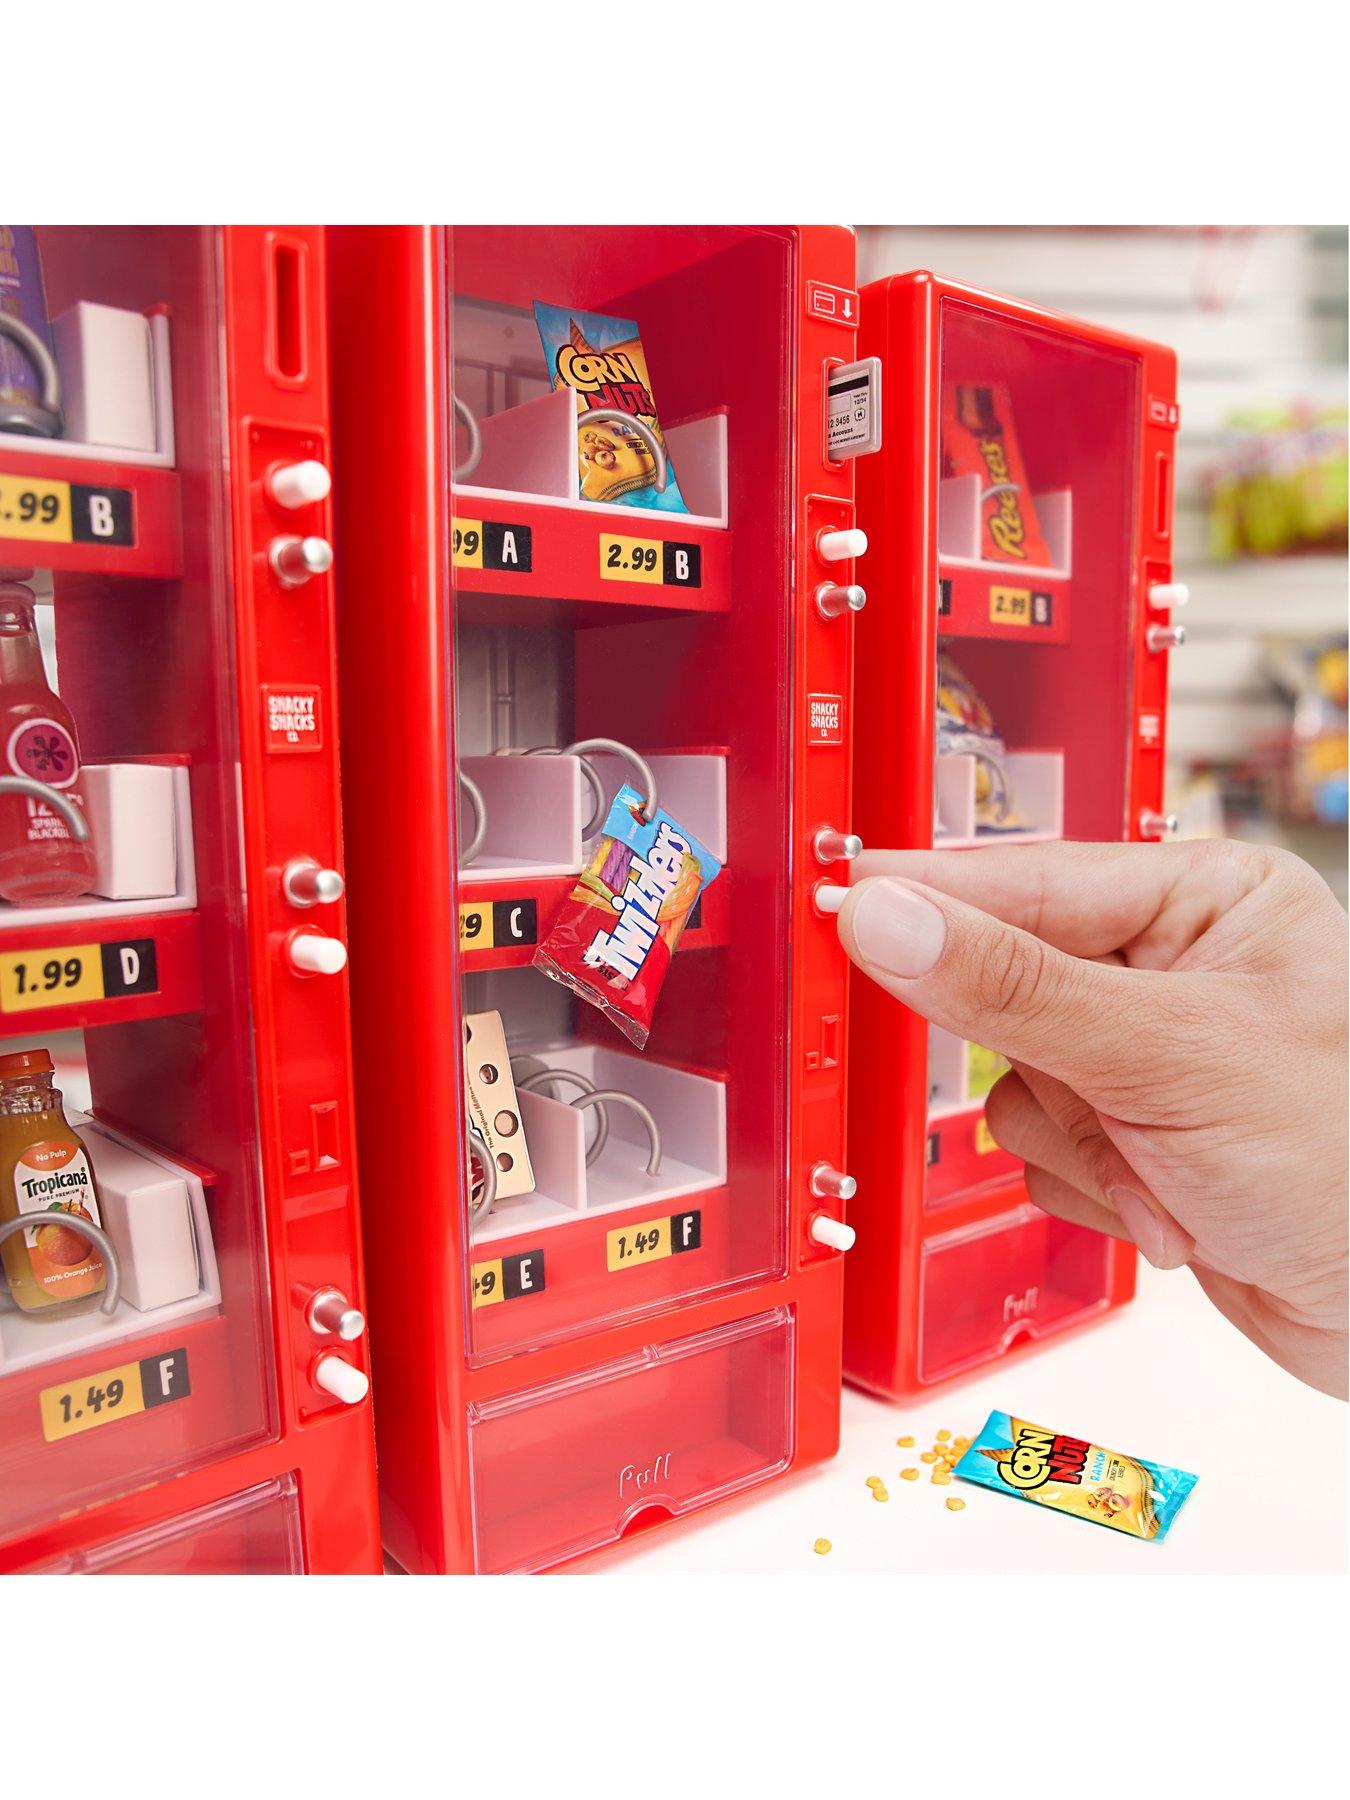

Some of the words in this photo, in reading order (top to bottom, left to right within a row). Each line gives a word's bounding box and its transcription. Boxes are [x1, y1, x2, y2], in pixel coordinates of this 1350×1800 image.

[556, 344, 640, 393] CORN
[0, 491, 60, 523] .99
[89, 494, 115, 537] B
[502, 530, 518, 564] A
[607, 544, 657, 572] 2.99
[675, 550, 690, 580] B
[268, 695, 315, 714] SNACKY
[811, 702, 839, 716] SNACKY
[269, 713, 316, 731] SNACKS
[811, 715, 839, 729] SNACKS
[510, 906, 523, 938] C
[13, 957, 83, 994] 1.99
[119, 946, 141, 985] D
[35, 1153, 49, 1163] No
[49, 1149, 67, 1160] Pulp
[21, 1170, 88, 1199] Tropicana
[38, 1194, 54, 1203] PURE
[55, 1188, 80, 1199] PREMIUM
[618, 1229, 660, 1259] 1.49
[682, 1215, 693, 1246] F
[43, 1271, 64, 1284] 100%
[64, 1267, 88, 1280] Orange
[520, 1259, 533, 1290] E
[59, 1378, 125, 1424] 1.49
[159, 1357, 175, 1396] F
[997, 1428, 1055, 1490] CORN
[1090, 1451, 1106, 1482] RANCH
[619, 1453, 673, 1499] Pull
